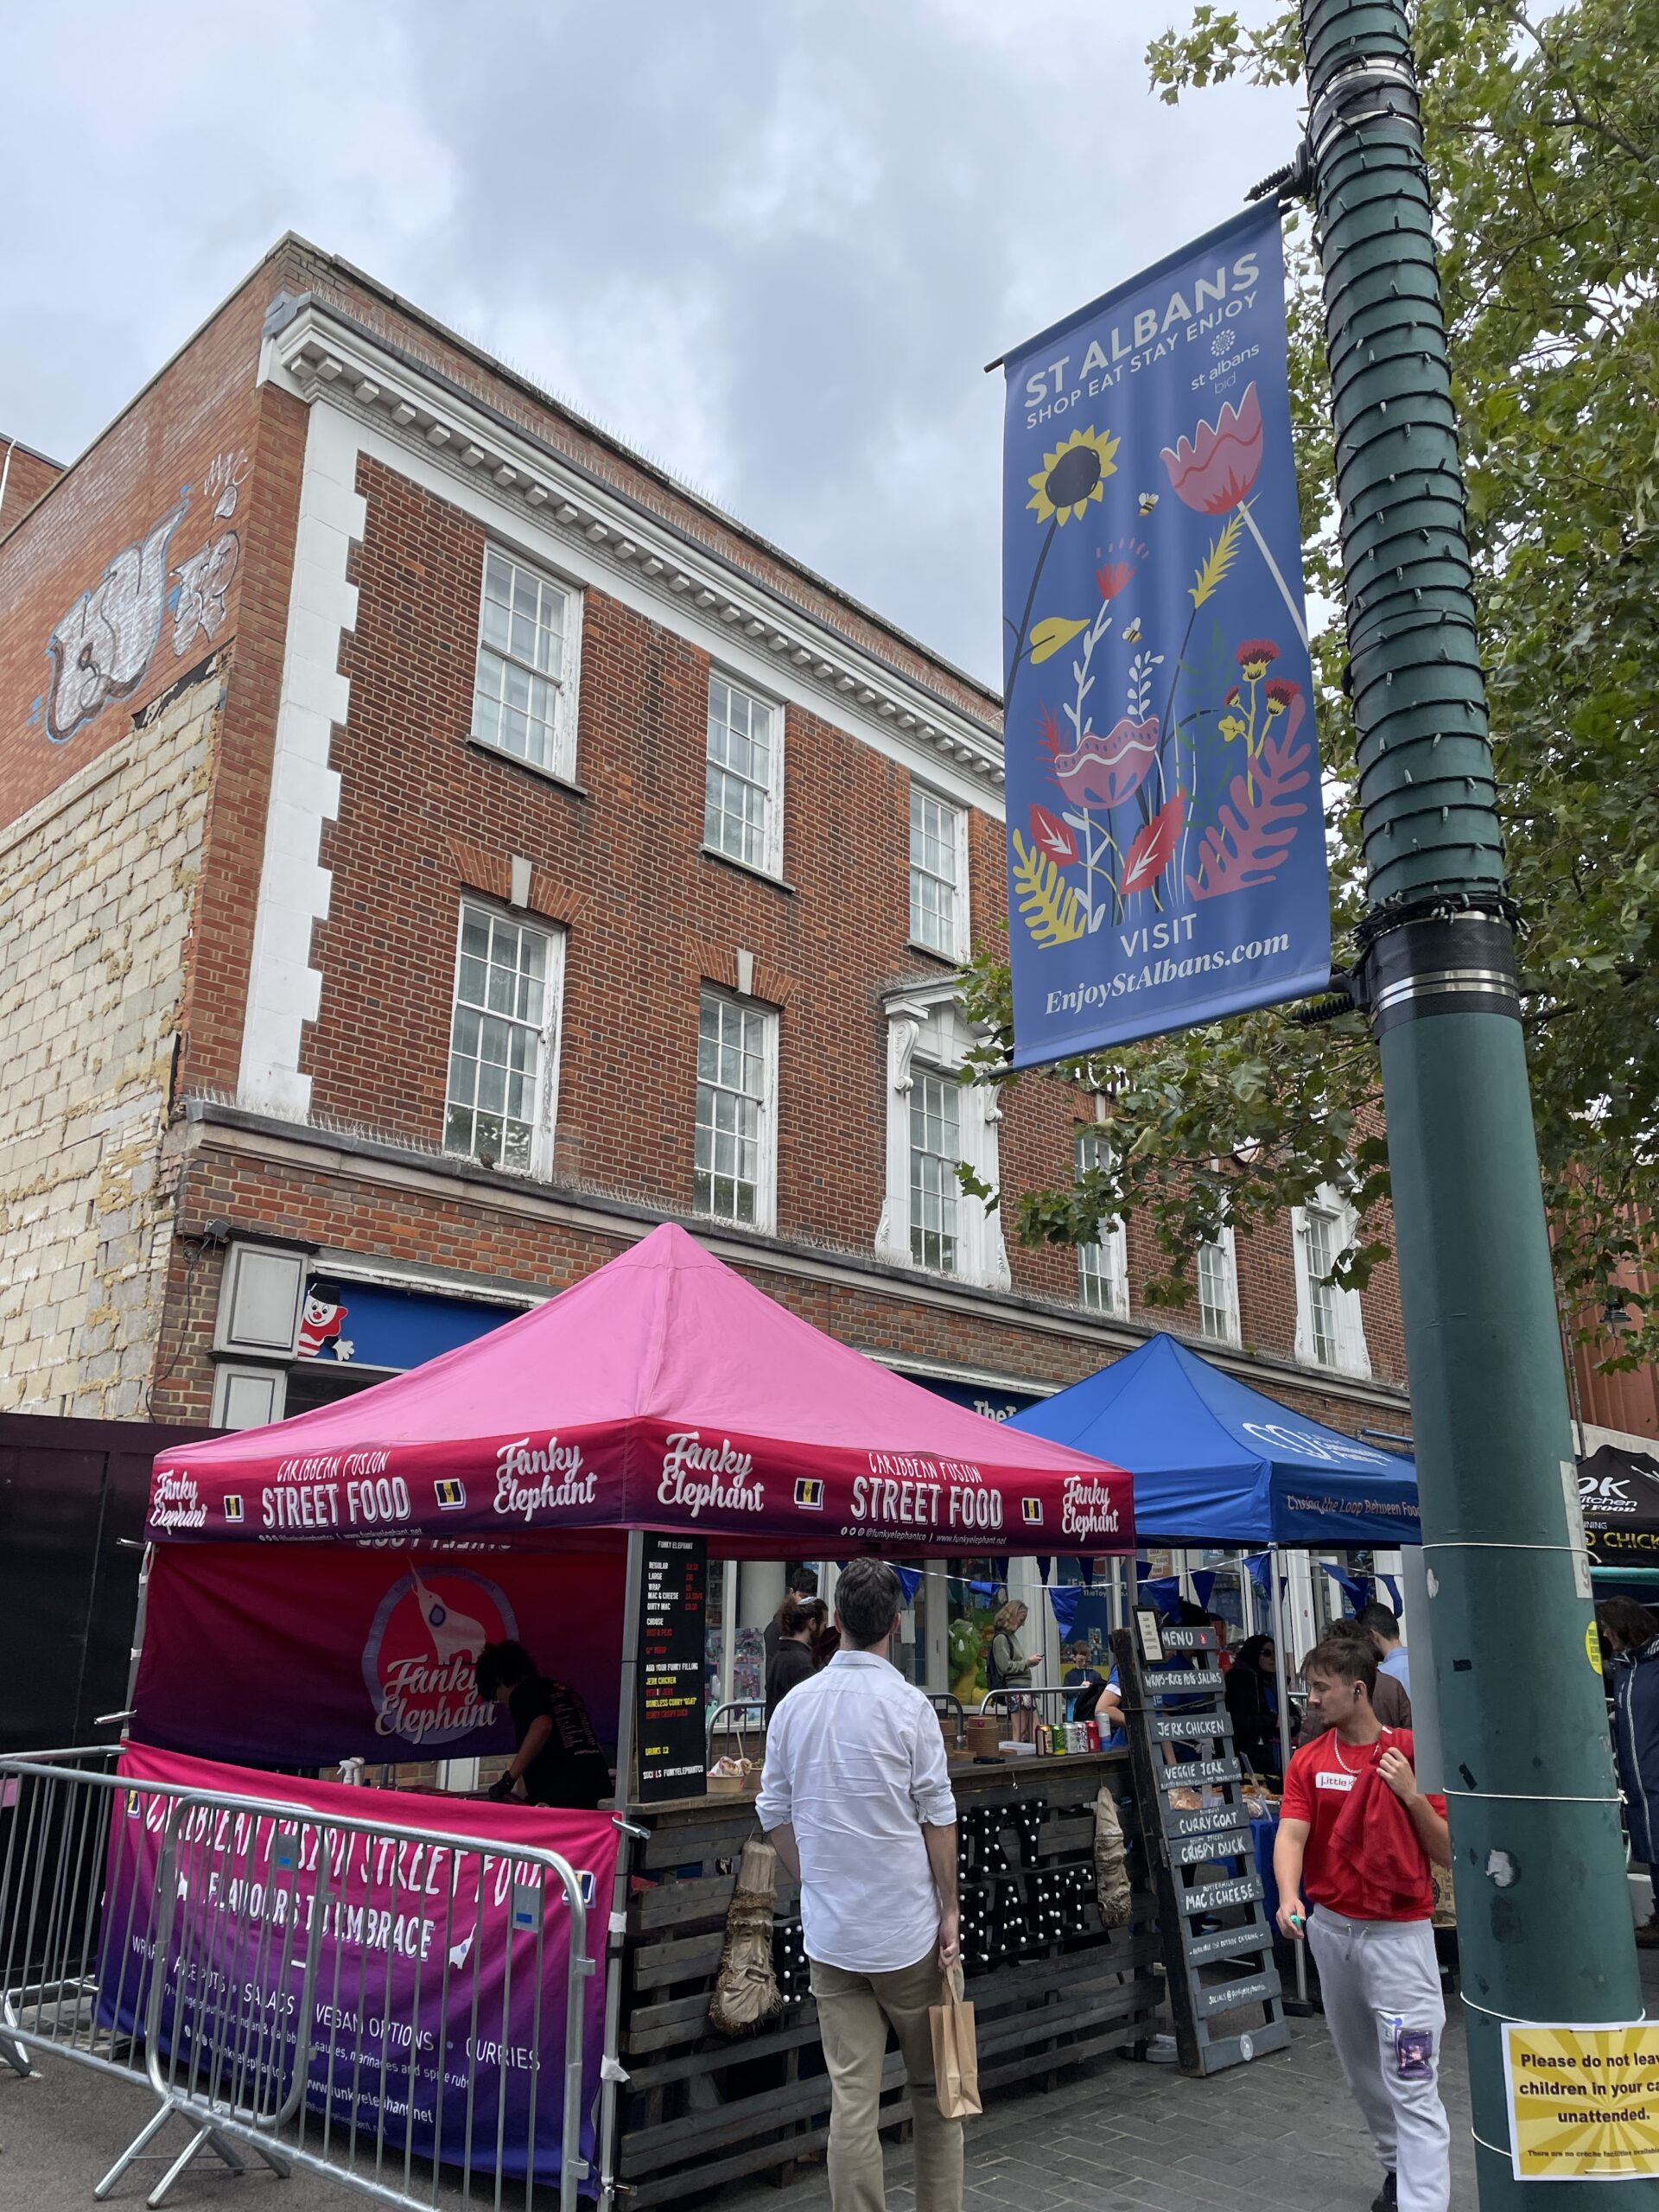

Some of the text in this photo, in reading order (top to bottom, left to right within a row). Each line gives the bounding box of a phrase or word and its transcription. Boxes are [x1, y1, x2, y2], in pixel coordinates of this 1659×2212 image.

[1024, 252, 1261, 409] ST ALBANS
[1026, 290, 1258, 429] SHOP EAT STAY ENJOY
[1191, 343, 1260, 391] st albans
[1214, 371, 1236, 395] bid
[1119, 913, 1197, 958] VISIT
[1045, 933, 1289, 1015] EnjoyStAlbans.com
[276, 1450, 391, 1482] CARIBBEAN FUSION
[868, 1452, 983, 1484] CARIBBEAN FUSION
[262, 1477, 411, 1529] STREET FOOD
[493, 1471, 598, 1522] Elephant
[657, 1465, 765, 1518] Elephant
[850, 1475, 1003, 1530] STREET FOOD
[1322, 1497, 1337, 1512] the
[1339, 1498, 1363, 1516] Loop
[1364, 1500, 1401, 1516] Between
[149, 1497, 207, 1535] Elephant
[1061, 1501, 1119, 1542] Elephant
[866, 1527, 1007, 1546] @funkyelephantco www.funkyelephant.net
[1162, 1631, 1193, 1646] MENU
[375, 1694, 500, 1745] Elephant
[1157, 1719, 1224, 1737] JERK CHICKEN
[1166, 1764, 1196, 1780] VEGGIE
[1200, 1761, 1224, 1776] JERK
[1321, 1776, 1346, 1787] Little
[1179, 1815, 1213, 1834] CURRY
[1181, 1836, 1246, 1863] CRISPY DUCK
[1185, 1893, 1208, 1910] MAC
[1216, 1884, 1255, 1904] CHEESE
[316, 2003, 363, 2034] VEGAN
[466, 2037, 541, 2072] CURRIES
[1521, 2054, 1577, 2068] Please
[1582, 2054, 1601, 2067] do
[1606, 2054, 1630, 2067] not
[1519, 2081, 1659, 2097] children in your ca
[1558, 2107, 1650, 2123] unattended.
